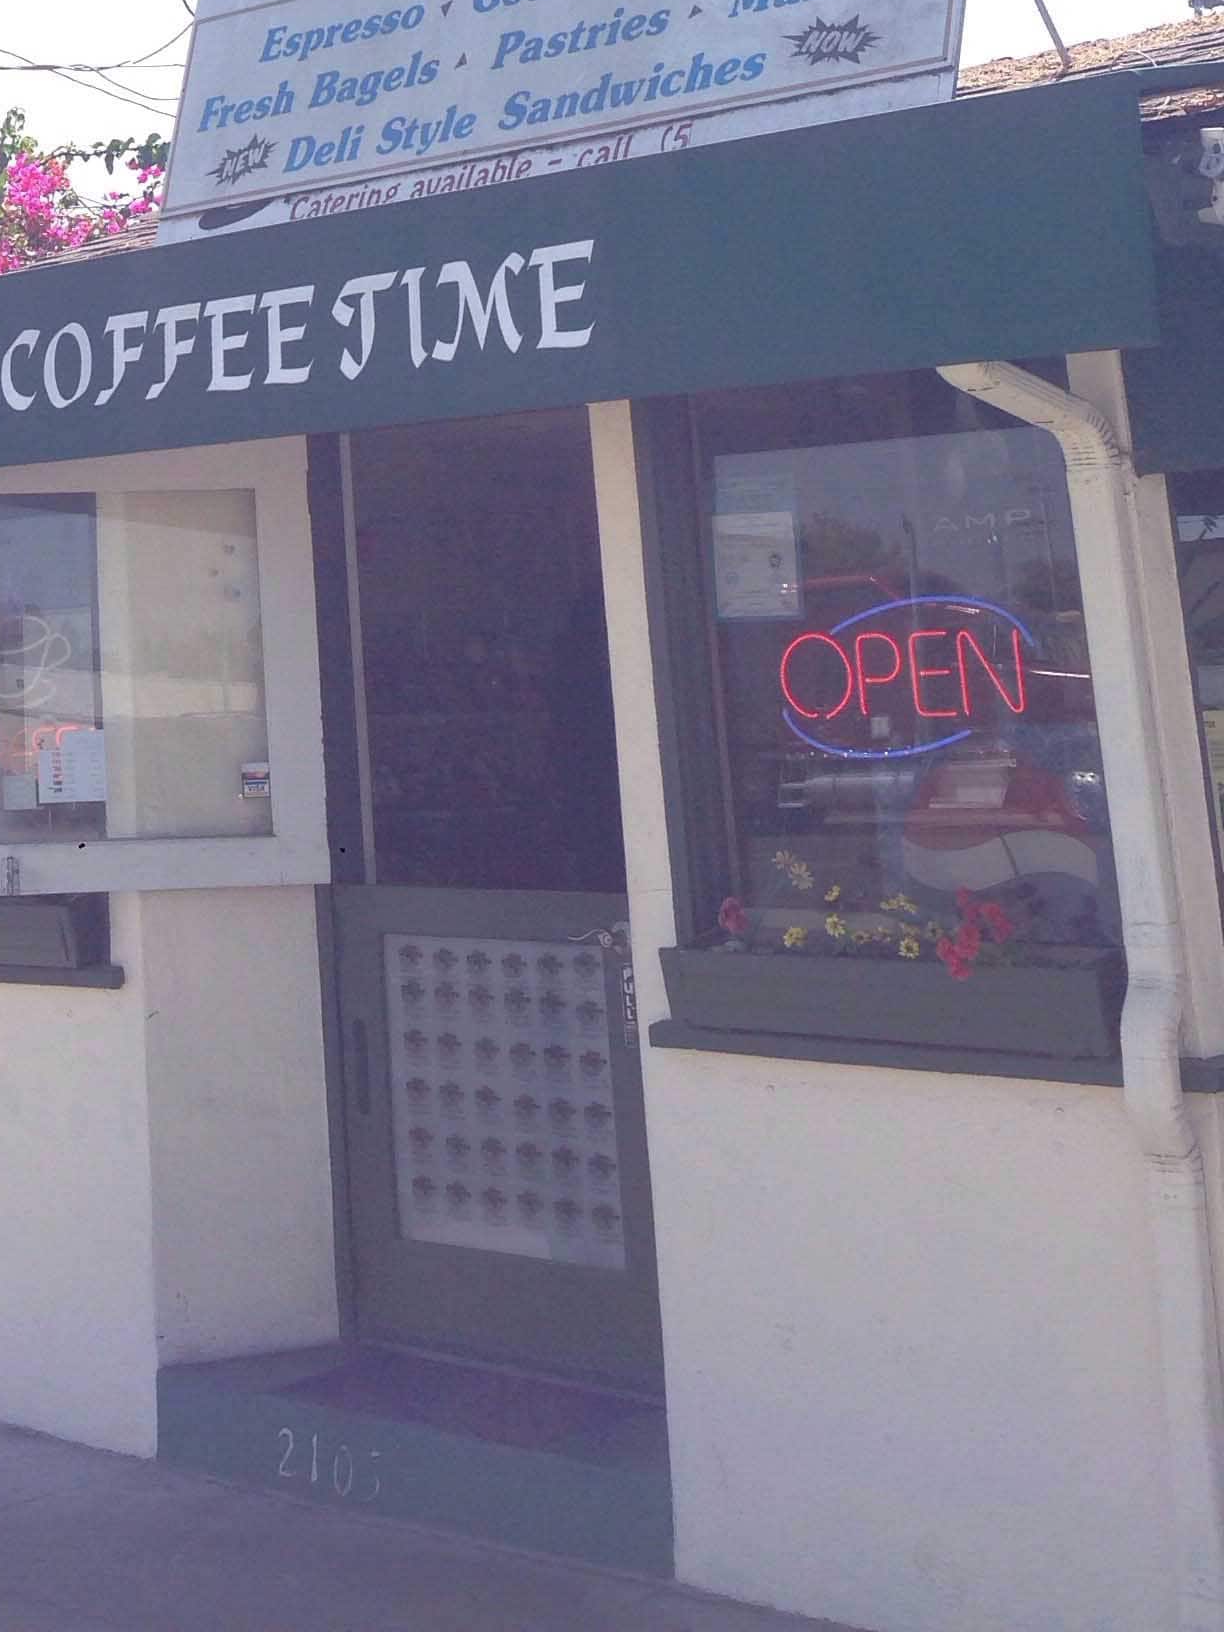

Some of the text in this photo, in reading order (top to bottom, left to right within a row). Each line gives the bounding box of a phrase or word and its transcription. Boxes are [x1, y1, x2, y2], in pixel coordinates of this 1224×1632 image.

[197, 83, 295, 134] Fresh
[309, 52, 440, 111] Bagels
[491, 7, 671, 70] Pastries
[260, 4, 425, 63] Espresso
[800, 28, 866, 54] NOW
[284, 52, 768, 174] Deli Style Sandwiches
[221, 141, 266, 180] NEW
[289, 181, 401, 221] Catering
[411, 154, 533, 198] available
[576, 134, 633, 168] call
[1, 239, 597, 411] COFFEE TIME
[781, 629, 1027, 719] OPEN
